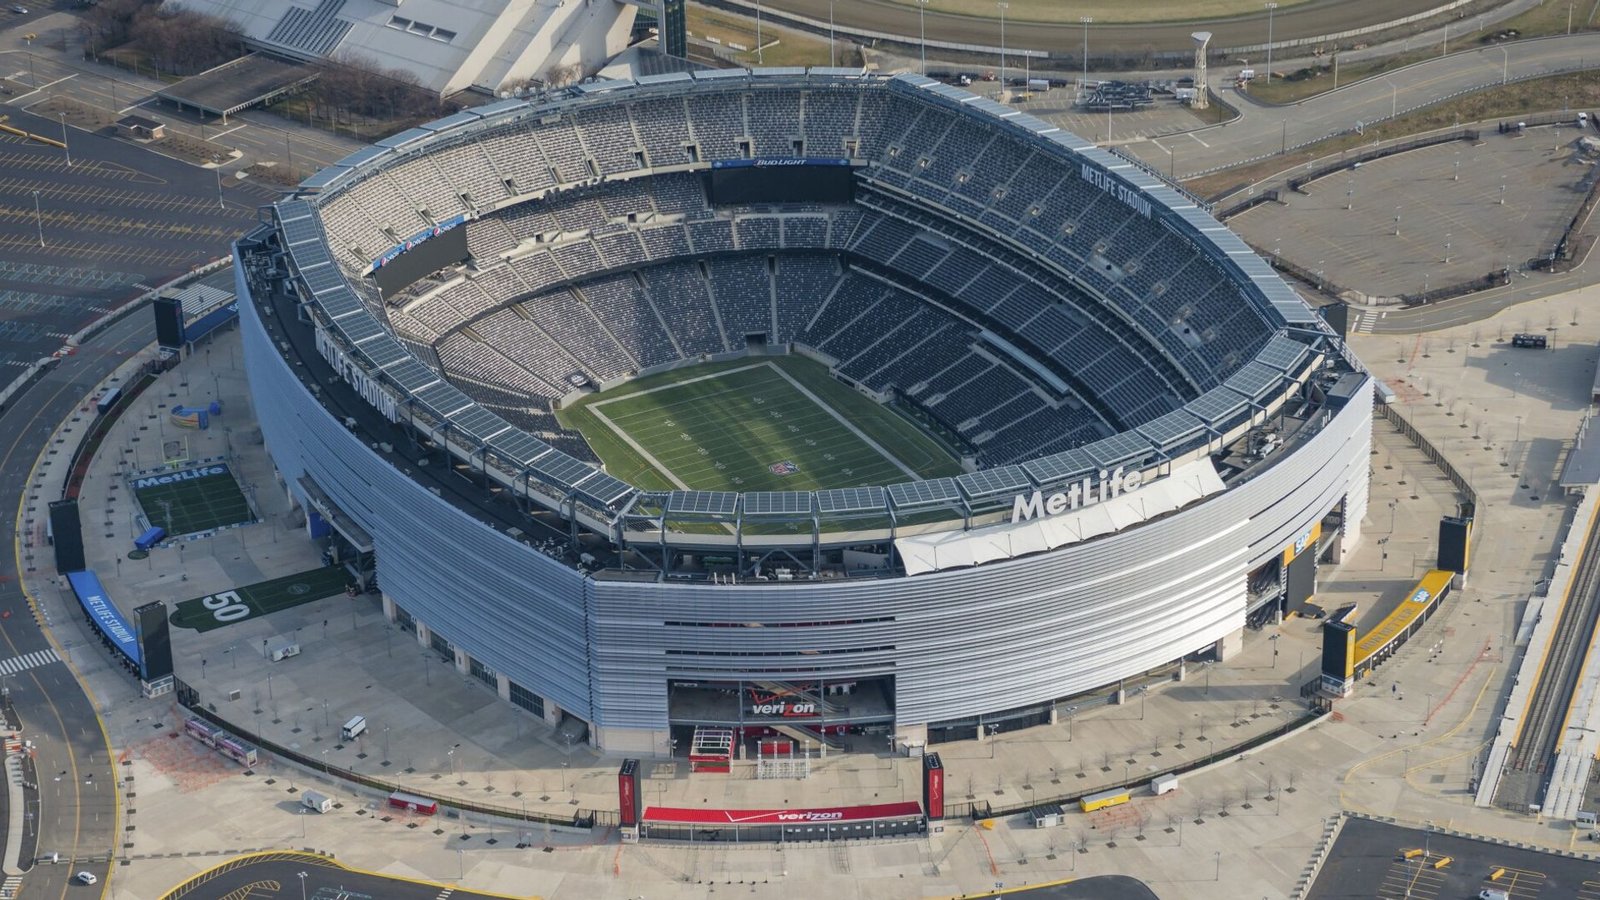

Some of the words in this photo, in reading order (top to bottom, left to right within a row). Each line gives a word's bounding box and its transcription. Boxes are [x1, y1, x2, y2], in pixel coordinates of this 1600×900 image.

[1081, 163, 1116, 197] METLIFE
[1117, 185, 1152, 220] STADIUM
[351, 366, 400, 424] STADIUM
[138, 467, 224, 489] MetLife
[1011, 466, 1142, 524] MetLife
[87, 595, 115, 620] METLIFE
[104, 619, 135, 643] STADIUM
[202, 590, 251, 622] 50
[752, 701, 816, 716] verizon
[778, 811, 843, 821] verizon
